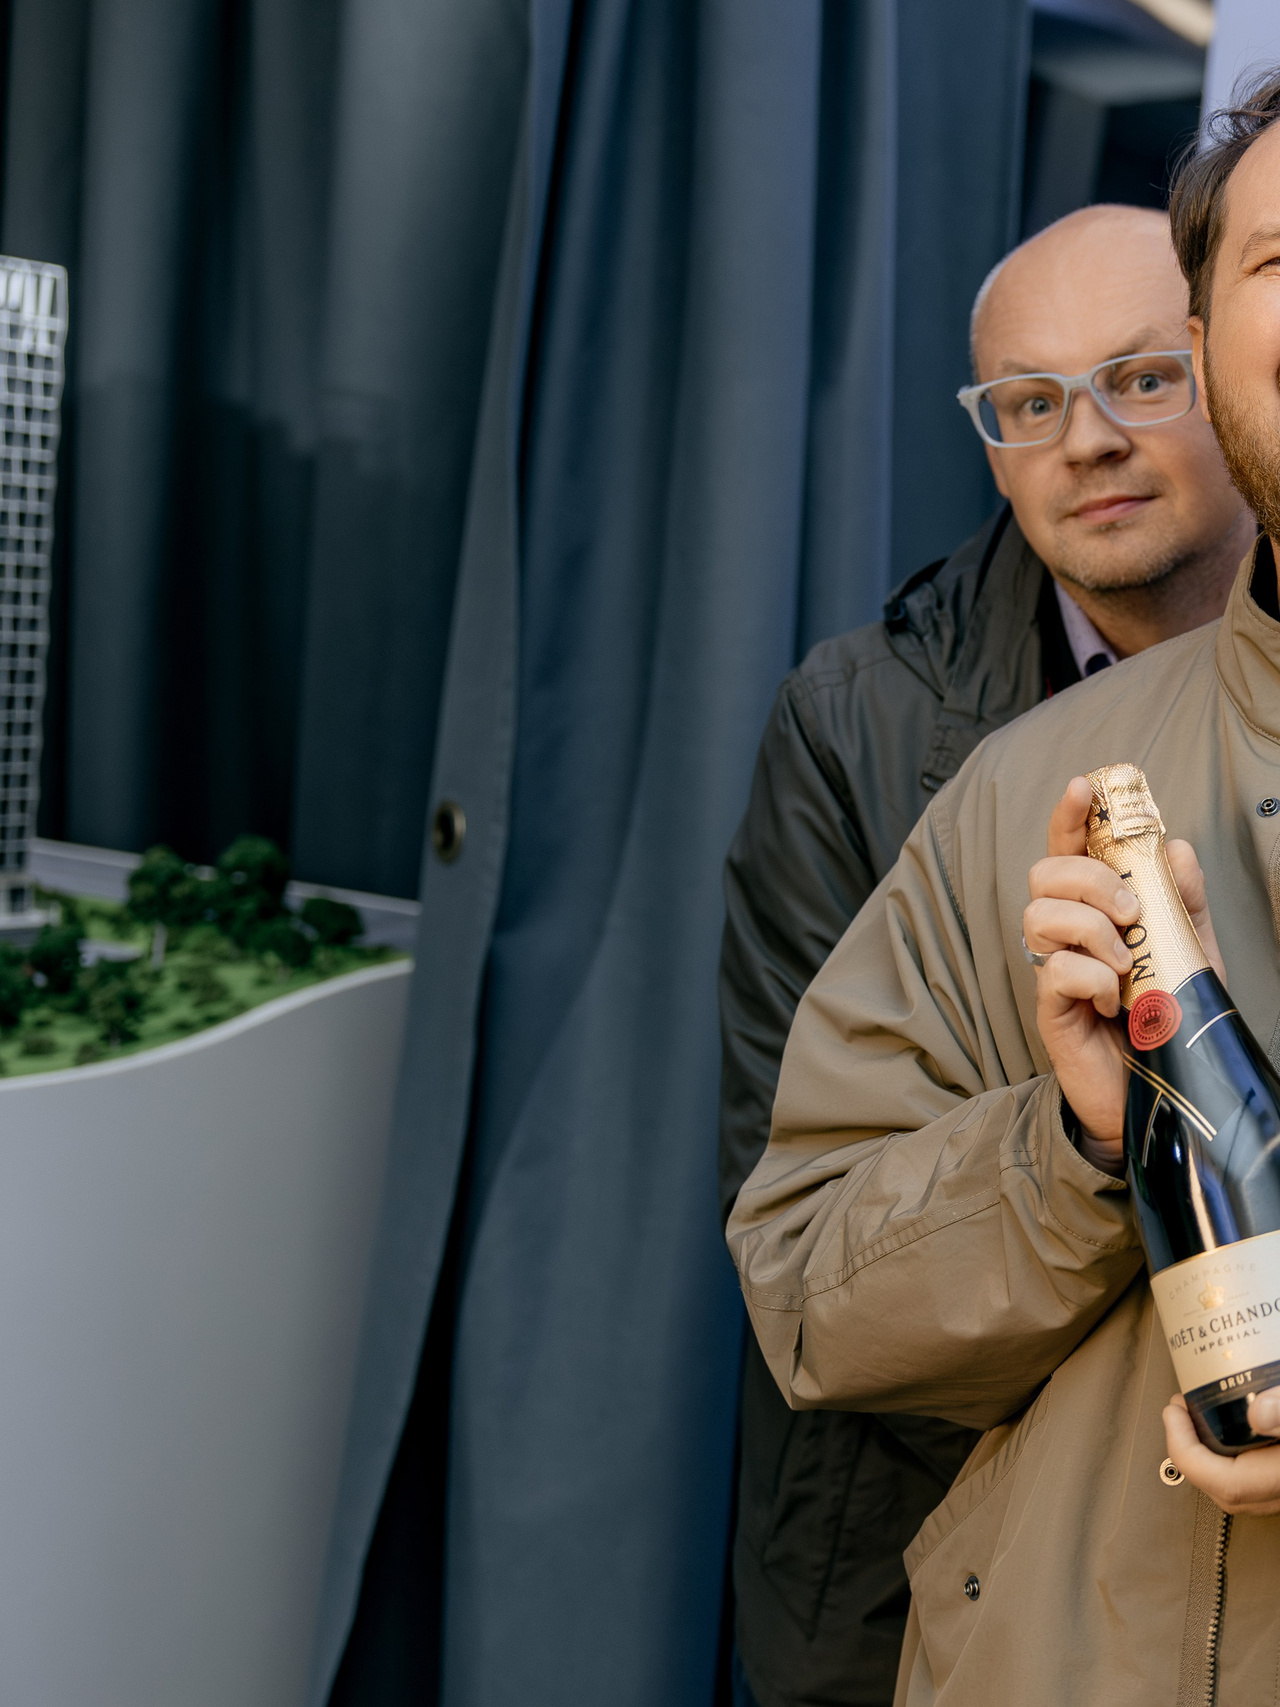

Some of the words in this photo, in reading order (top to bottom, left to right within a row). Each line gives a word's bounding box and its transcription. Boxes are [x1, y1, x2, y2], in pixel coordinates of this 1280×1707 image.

[1169, 1263, 1256, 1300] CHAMPAGNE
[1194, 1327, 1261, 1355] IMPÉRIAL
[1198, 1325, 1207, 1338] &
[1219, 1370, 1252, 1391] BRUT
